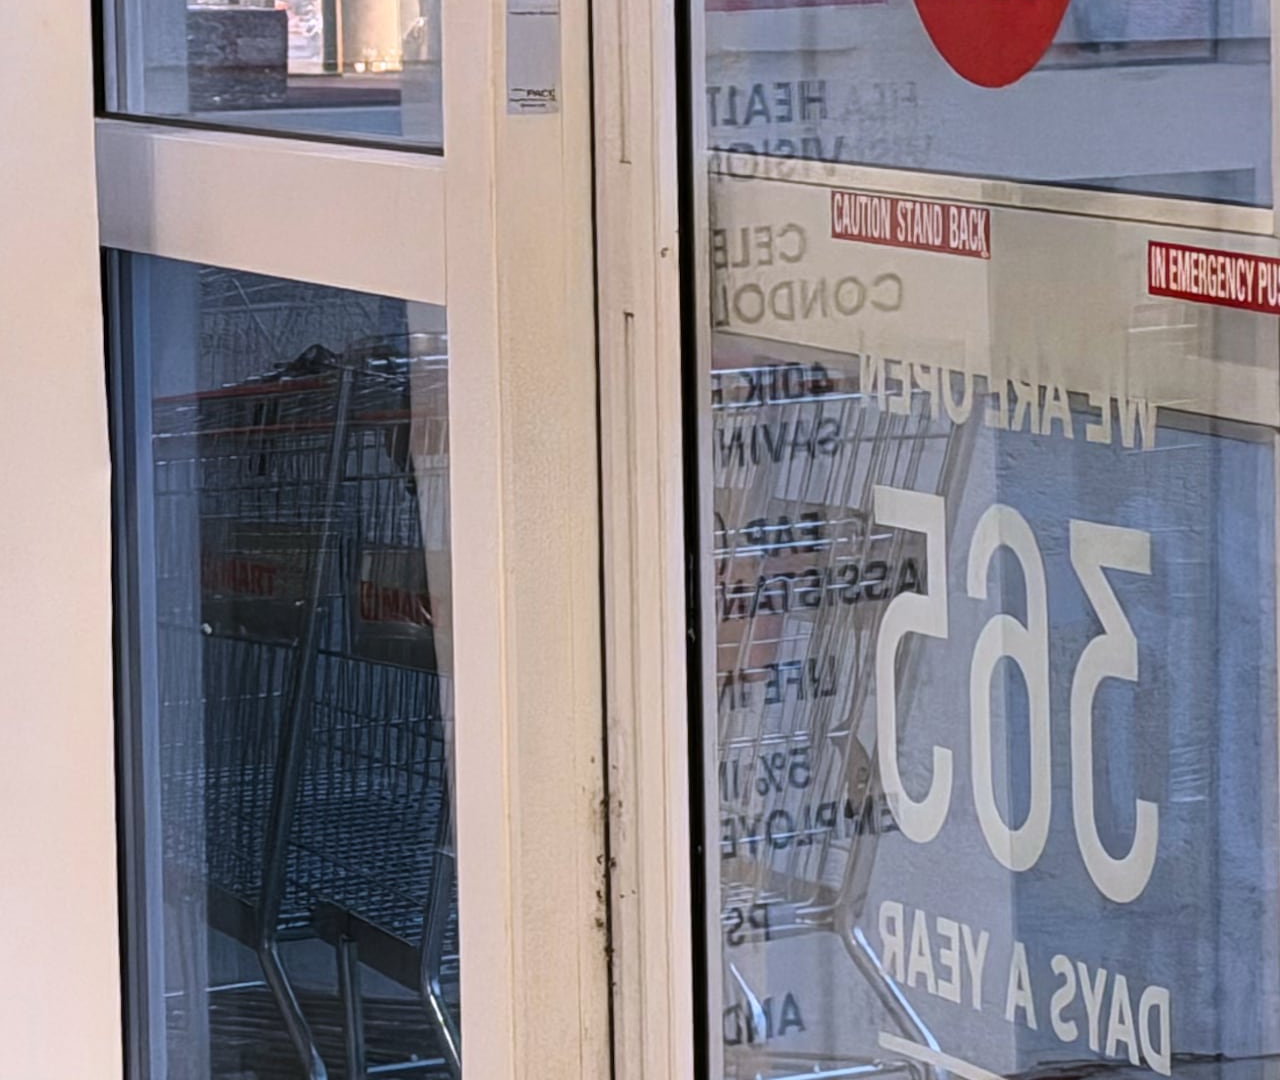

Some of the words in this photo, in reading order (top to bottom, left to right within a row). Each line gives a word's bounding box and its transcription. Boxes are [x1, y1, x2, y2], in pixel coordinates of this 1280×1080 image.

[833, 192, 891, 240] CAUTION
[897, 199, 943, 247] STAND
[950, 205, 988, 252] BACK
[1151, 246, 1166, 289] IN
[1170, 249, 1255, 303] EMERGENCY
